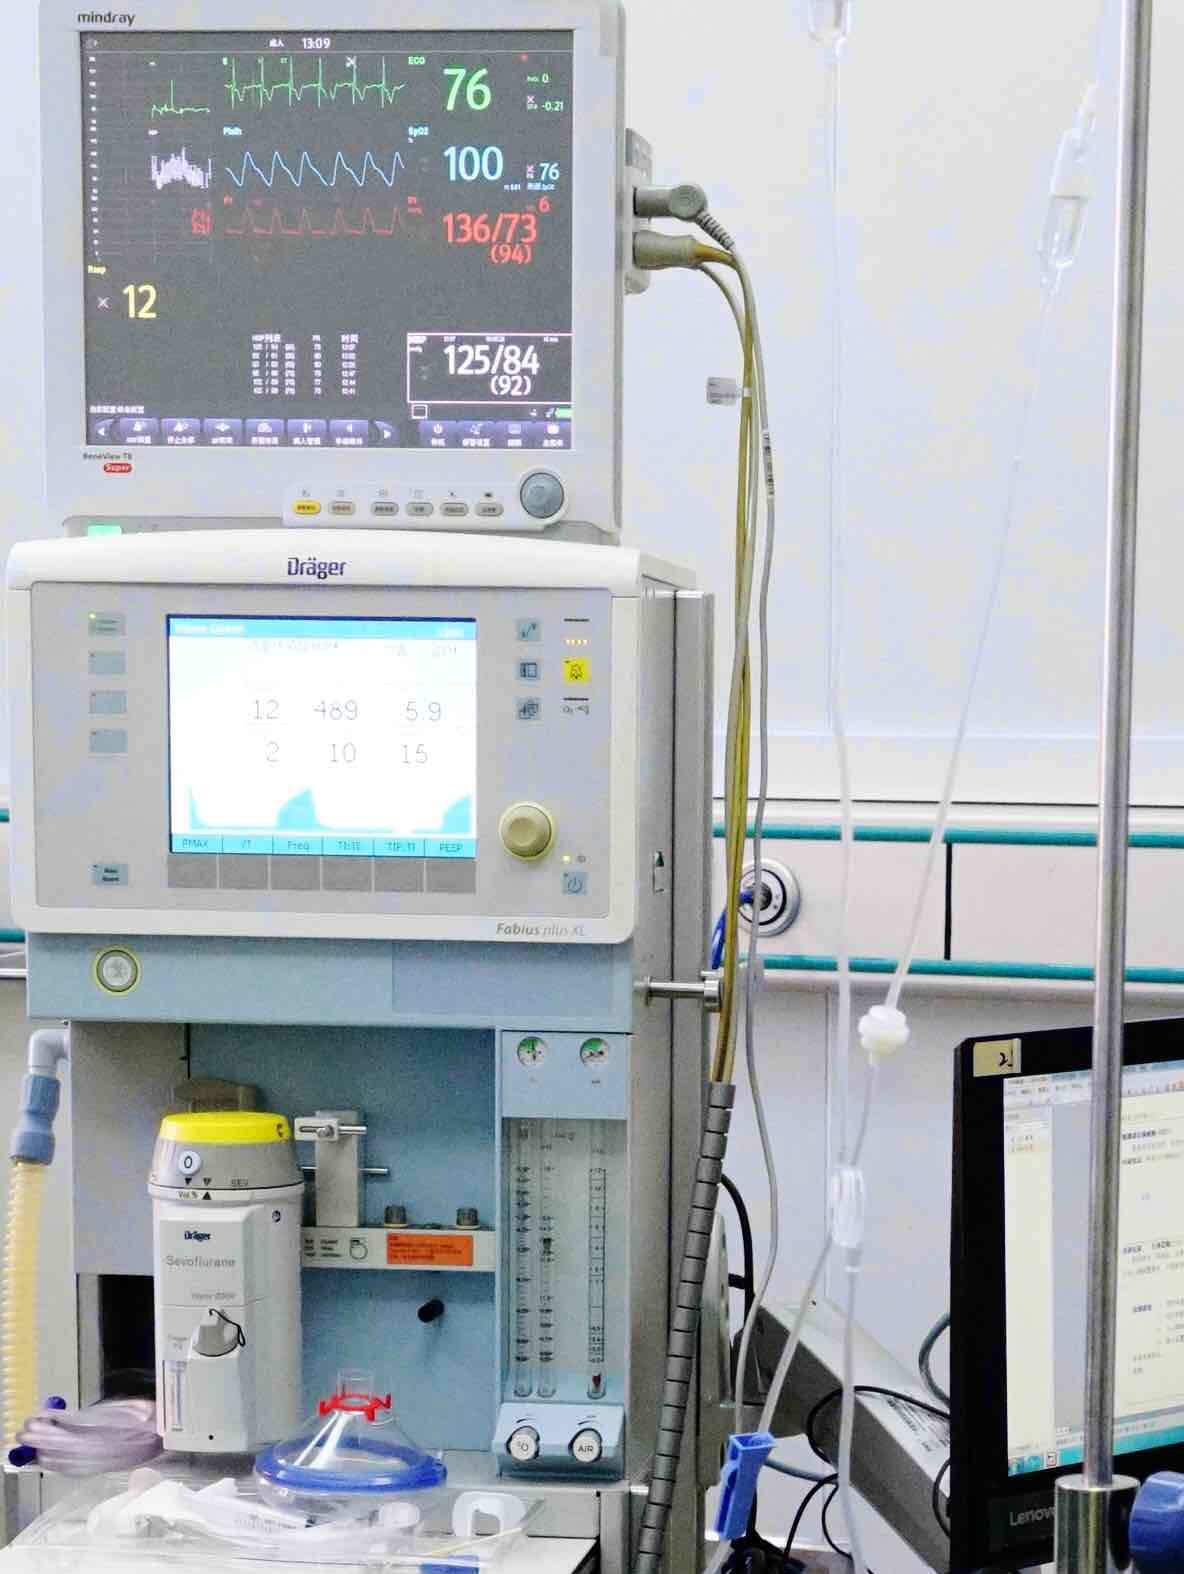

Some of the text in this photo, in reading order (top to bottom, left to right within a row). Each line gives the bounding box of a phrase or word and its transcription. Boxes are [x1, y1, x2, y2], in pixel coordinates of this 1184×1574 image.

[78, 11, 136, 26] mindray
[302, 37, 331, 49] 13:09
[443, 68, 492, 111] 76
[443, 146, 504, 181] 100
[539, 162, 560, 180] 76
[538, 196, 550, 213] 6
[442, 213, 537, 244] 136/73
[490, 243, 532, 264] (94)
[123, 284, 157, 319] 12
[443, 344, 540, 375] 125/84
[490, 375, 532, 396] (92)
[288, 556, 347, 580] Dräger
[254, 699, 280, 719] 12
[313, 700, 359, 720] 489
[266, 741, 428, 763] 2 10 15
[496, 923, 540, 936] Fabius
[184, 1231, 212, 1242] Dräger
[166, 1255, 237, 1267] Sevoflurane
[577, 1444, 594, 1453] AIR
[1010, 1506, 1056, 1527] Lenov
